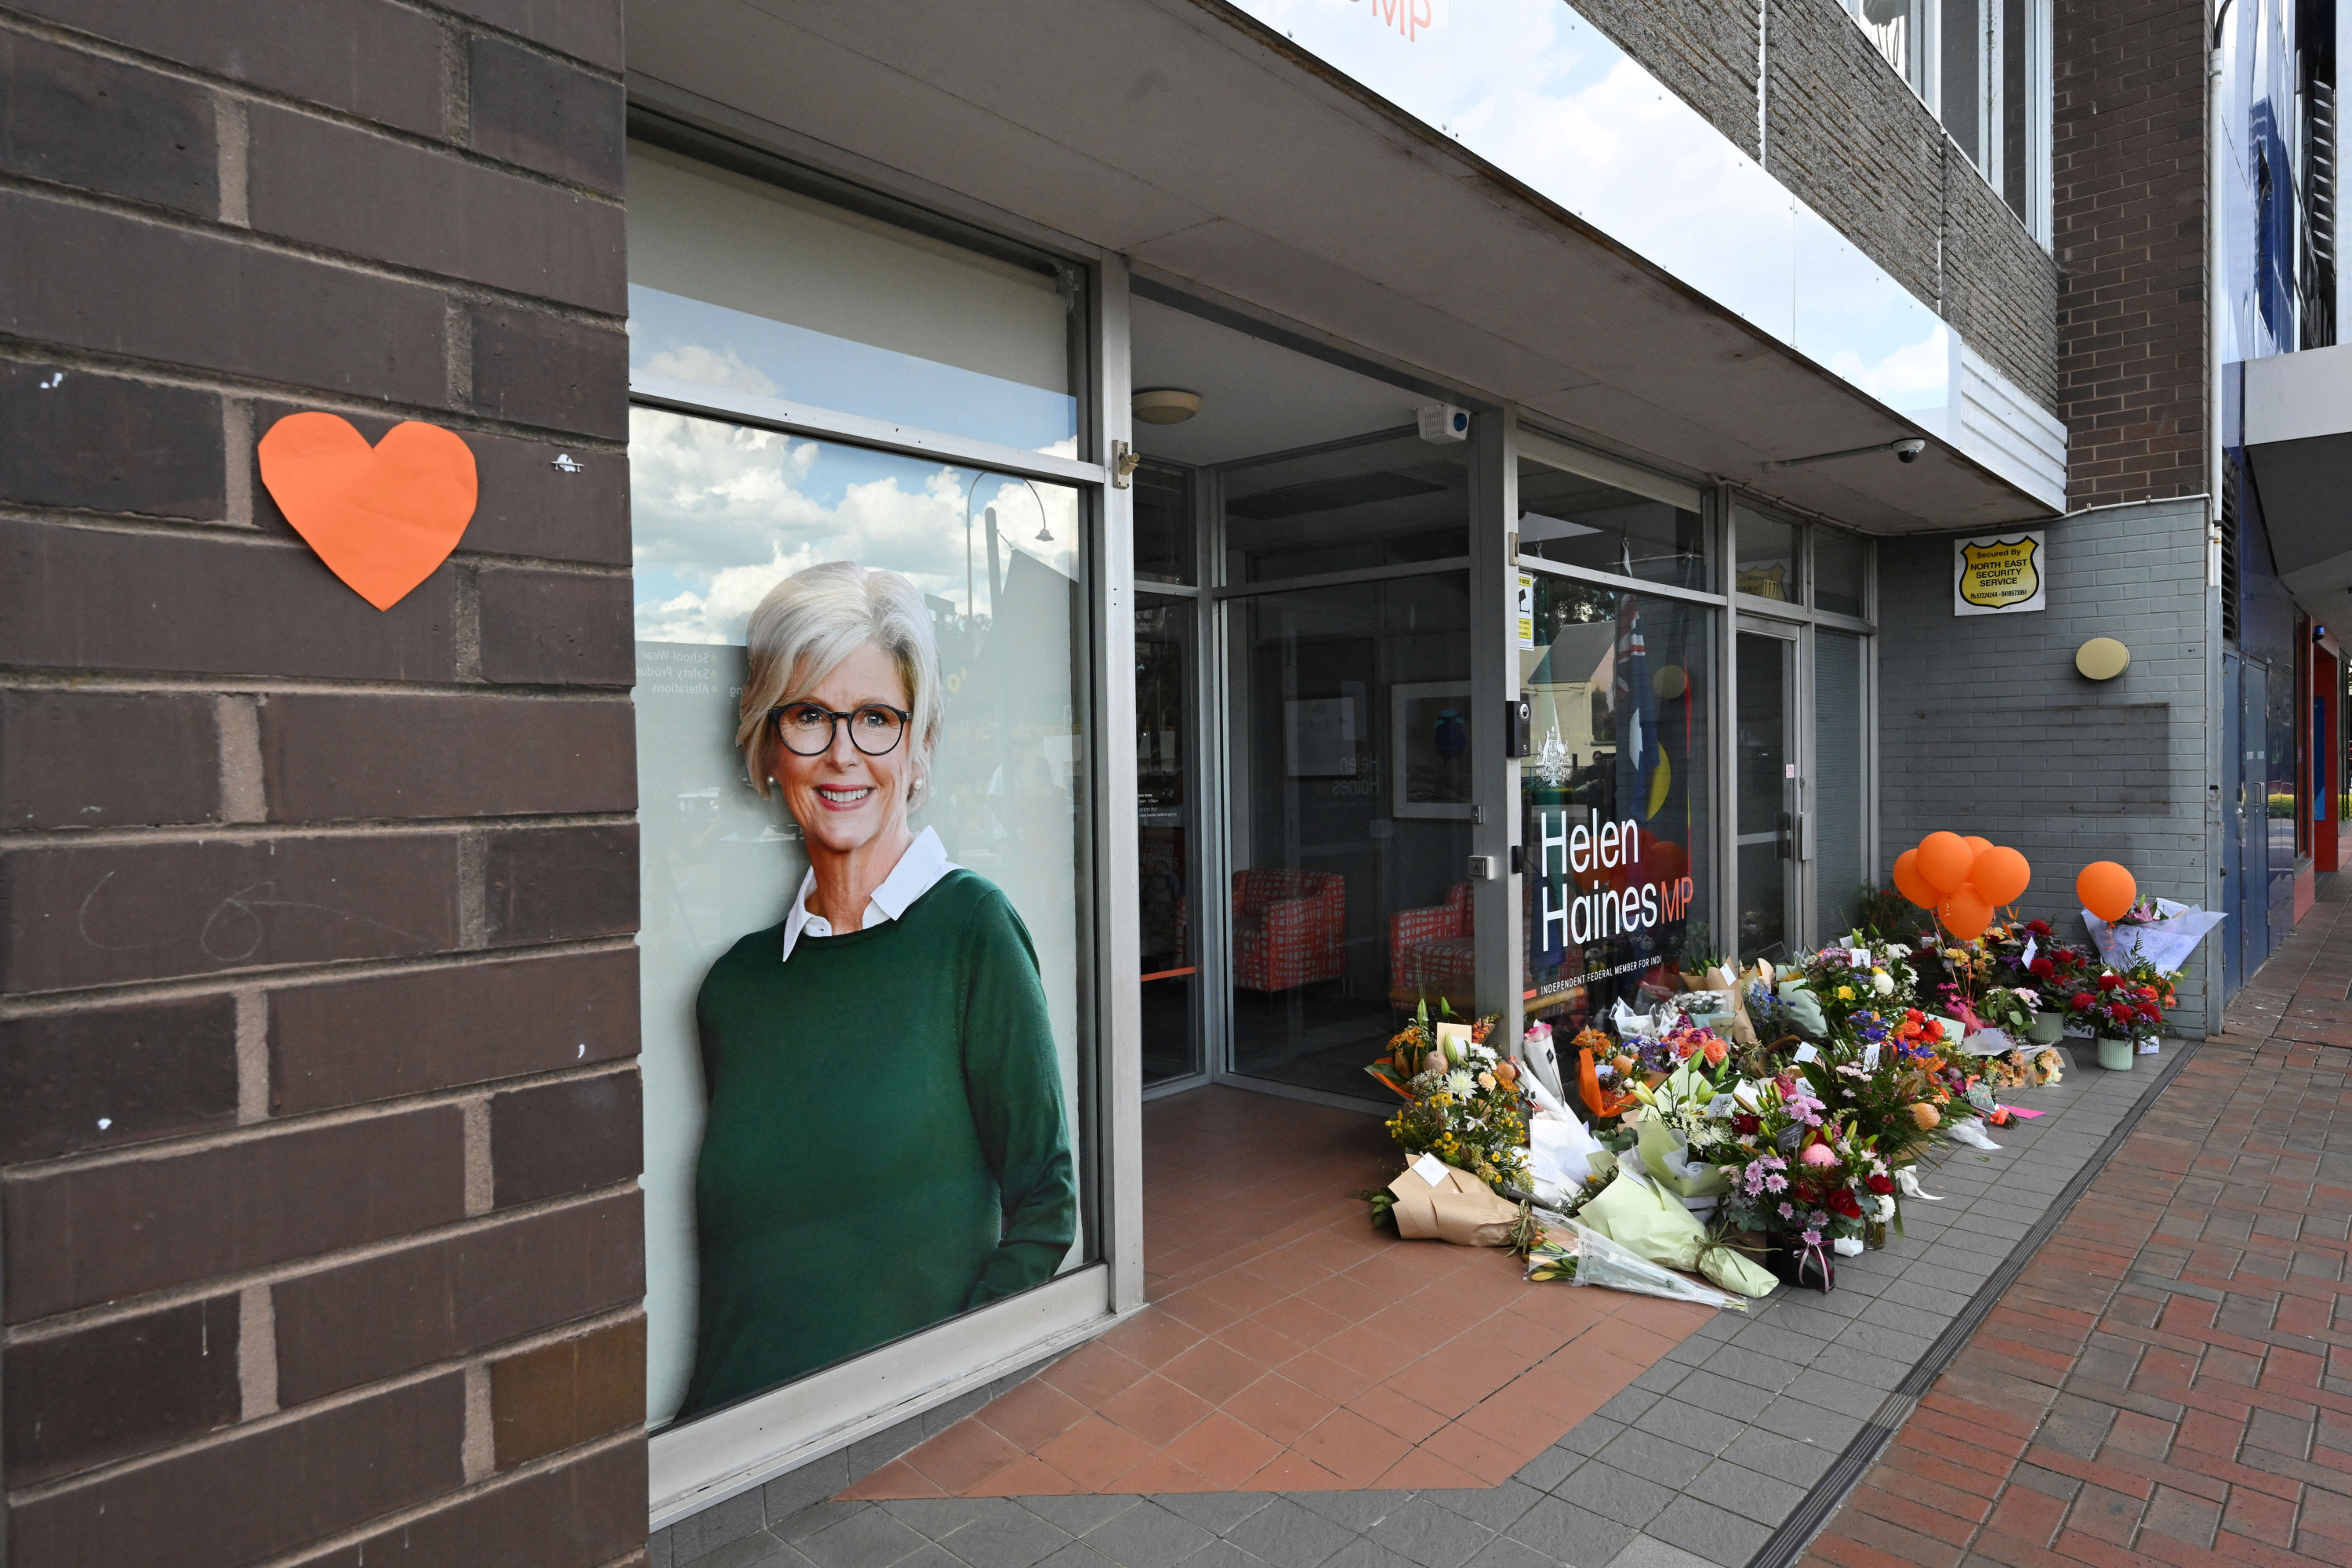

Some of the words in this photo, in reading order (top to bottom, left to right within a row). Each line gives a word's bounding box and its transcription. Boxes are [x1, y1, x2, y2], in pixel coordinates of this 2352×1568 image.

[1976, 550, 2009, 559] Secured
[1970, 561, 2001, 571] NORTH
[2005, 559, 2027, 568] EAST
[1976, 568, 2022, 579] SECURITY
[1765, 581, 1776, 597] 117
[1980, 577, 2018, 587] SERVICE
[1541, 808, 1639, 877] Helen
[1542, 880, 1657, 952] Haines
[1661, 877, 1693, 924] MP
[1541, 975, 1586, 996] INDEPENDENT
[1587, 968, 1613, 982] FEDERAL
[1614, 961, 1637, 975] MEMBER
[1639, 958, 1650, 969] FOR
[1650, 955, 1662, 966] INDI
